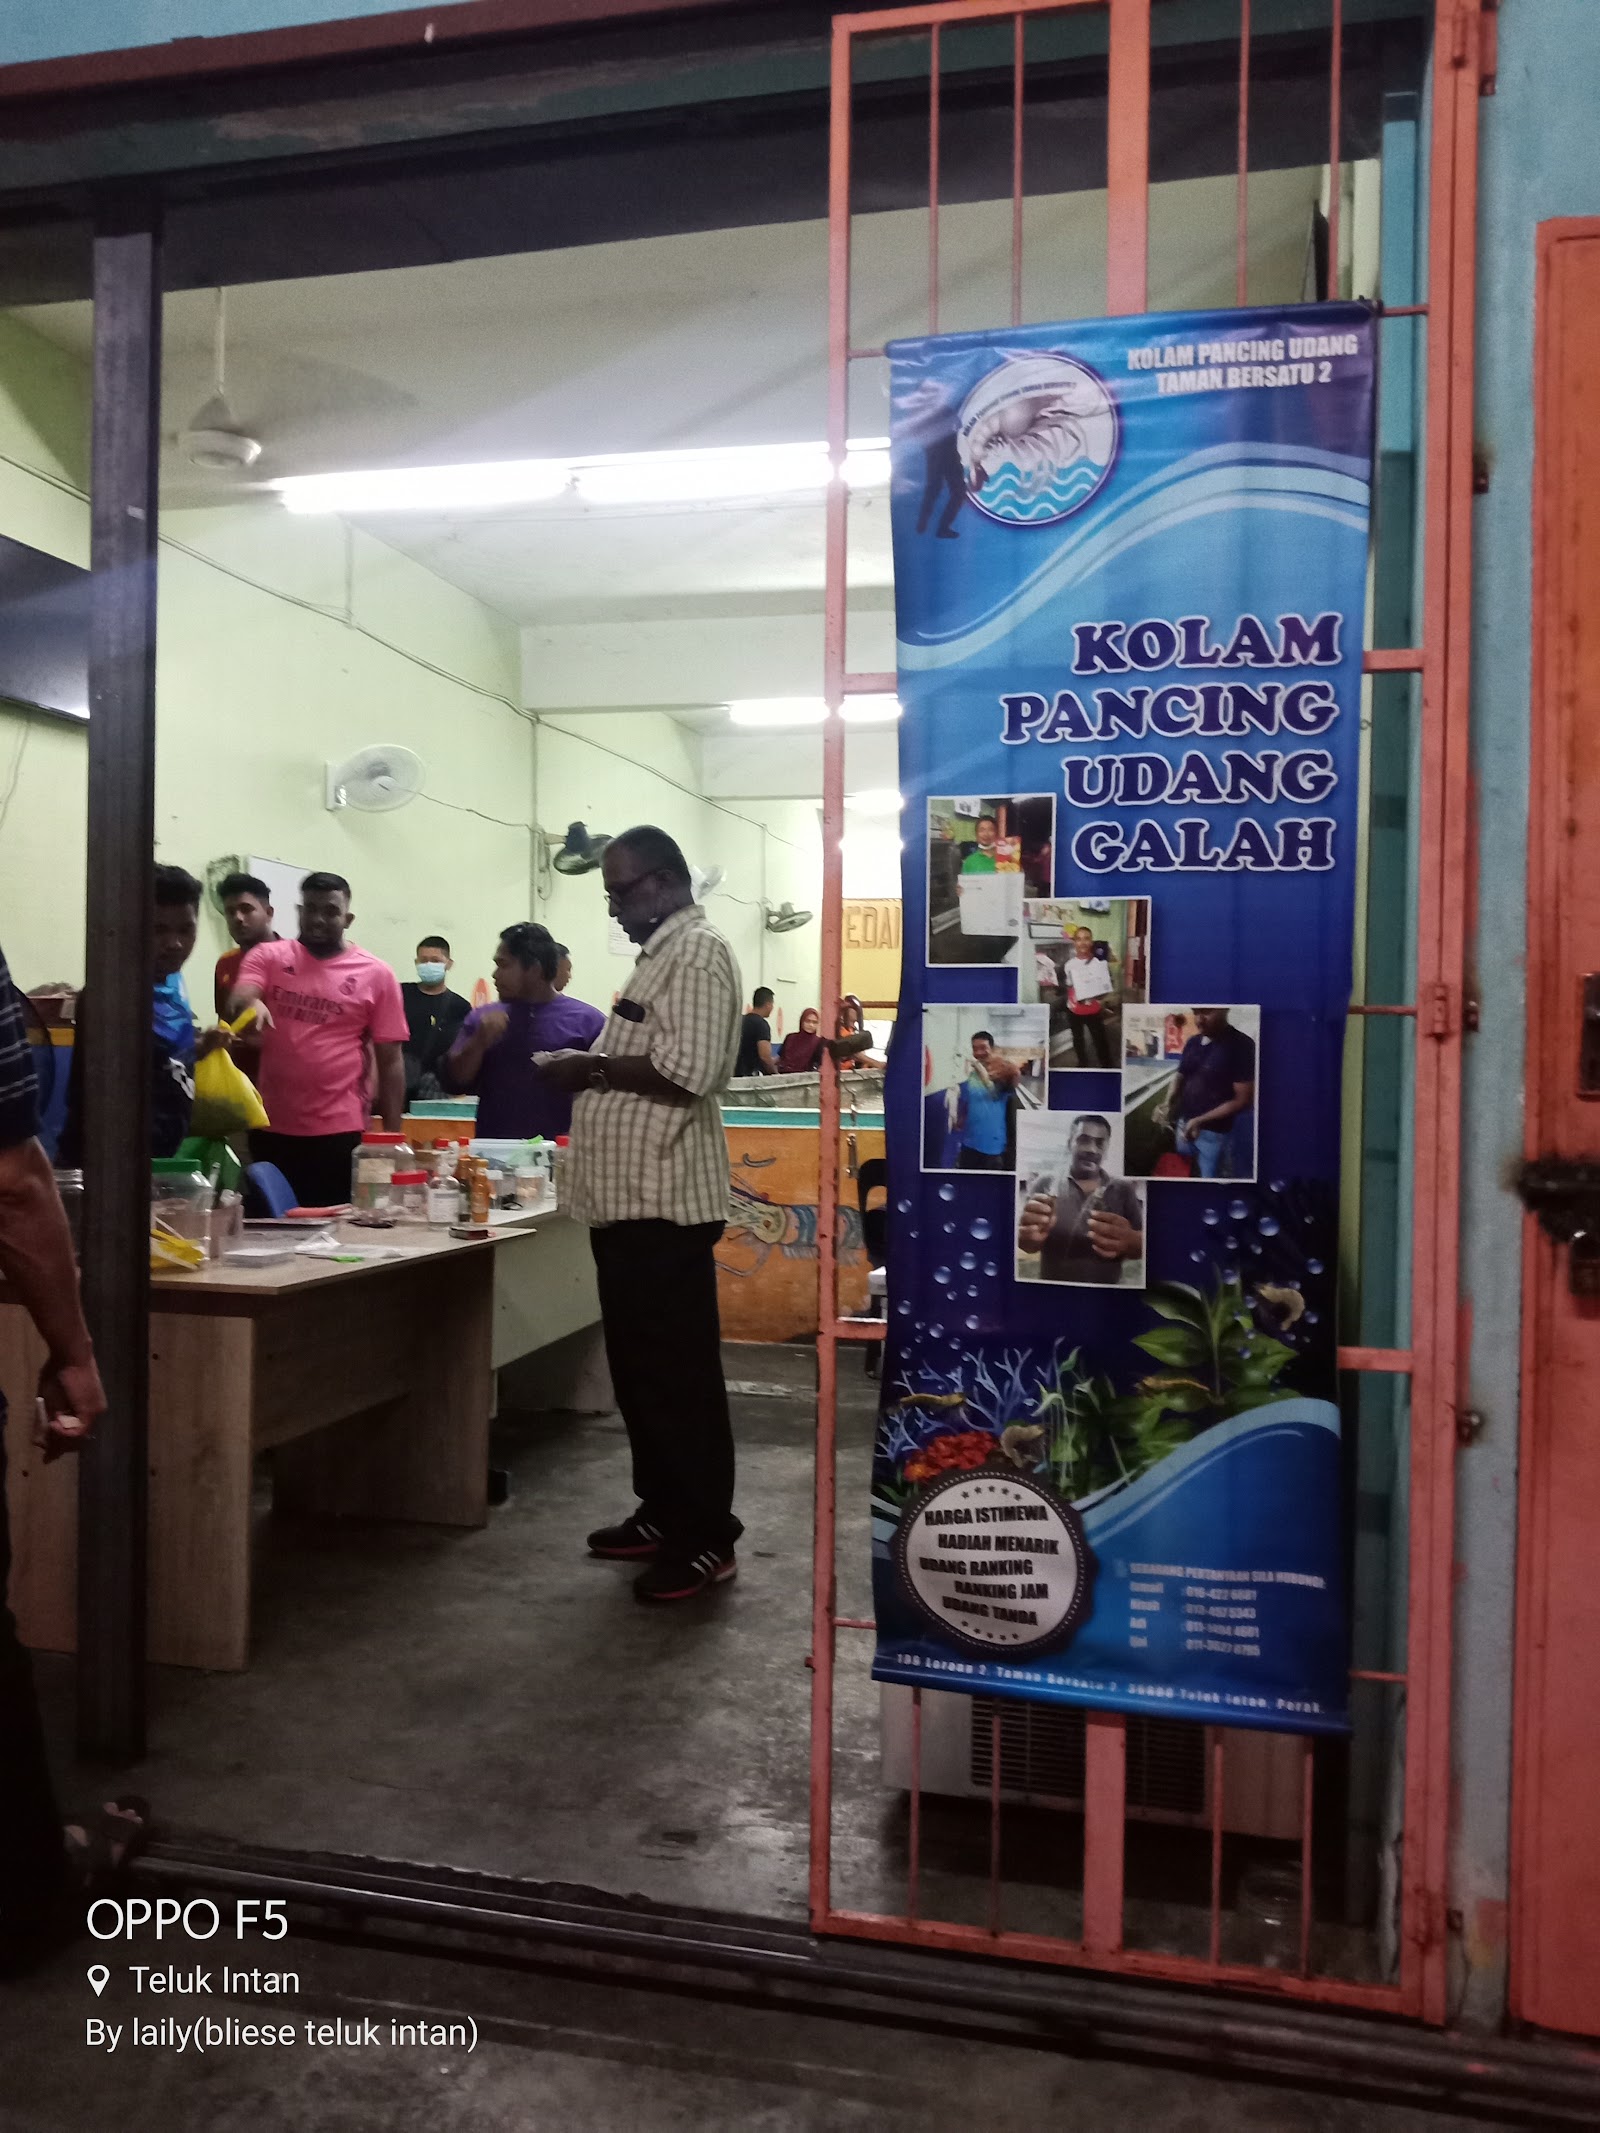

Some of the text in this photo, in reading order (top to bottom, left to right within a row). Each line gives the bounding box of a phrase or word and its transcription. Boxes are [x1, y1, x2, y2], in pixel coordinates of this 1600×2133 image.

[1128, 334, 1358, 370] KOLAM PANCING UDANG
[1157, 361, 1332, 395] TAMAN BERSATU 2
[1071, 613, 1343, 674] KOLAM
[1000, 682, 1339, 744] PANCING
[1062, 750, 1338, 807] UDANG
[1072, 818, 1336, 873] GALAH
[845, 906, 900, 949] EDAI
[924, 1505, 1048, 1525] HARGA ISTIMEWA
[938, 1534, 1059, 1555] HADIAH MENARIK
[919, 1557, 1033, 1575] UDANG RANKING
[954, 1581, 1049, 1599] RANKING JAM
